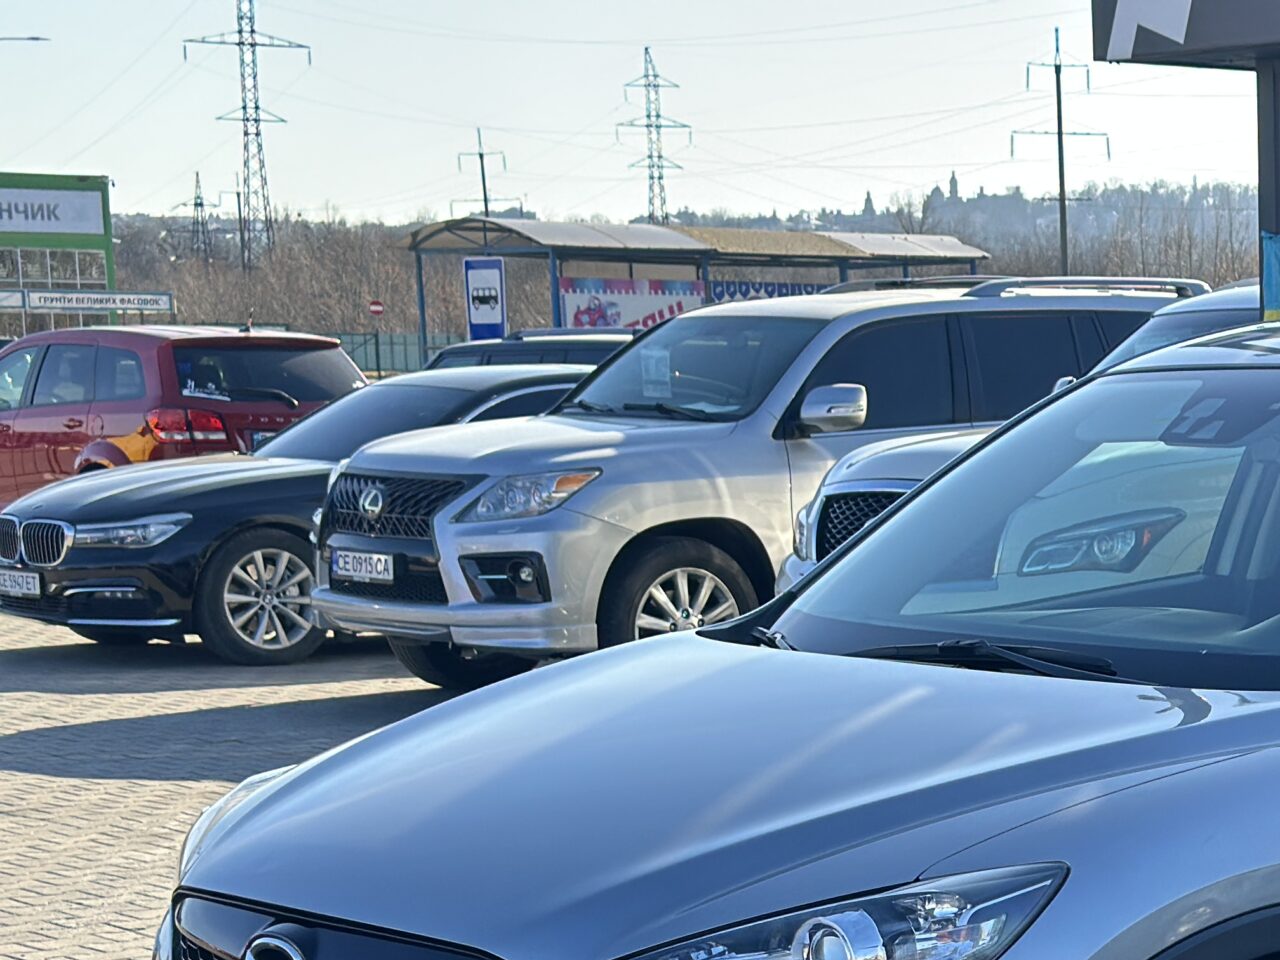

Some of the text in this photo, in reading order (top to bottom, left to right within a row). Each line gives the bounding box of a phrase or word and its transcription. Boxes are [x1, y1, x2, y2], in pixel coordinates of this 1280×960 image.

[75, 296, 117, 306] ВЕЛИКИХ
[119, 297, 161, 307] ФАСОВОК
[337, 554, 390, 576] CE 0915 CA
